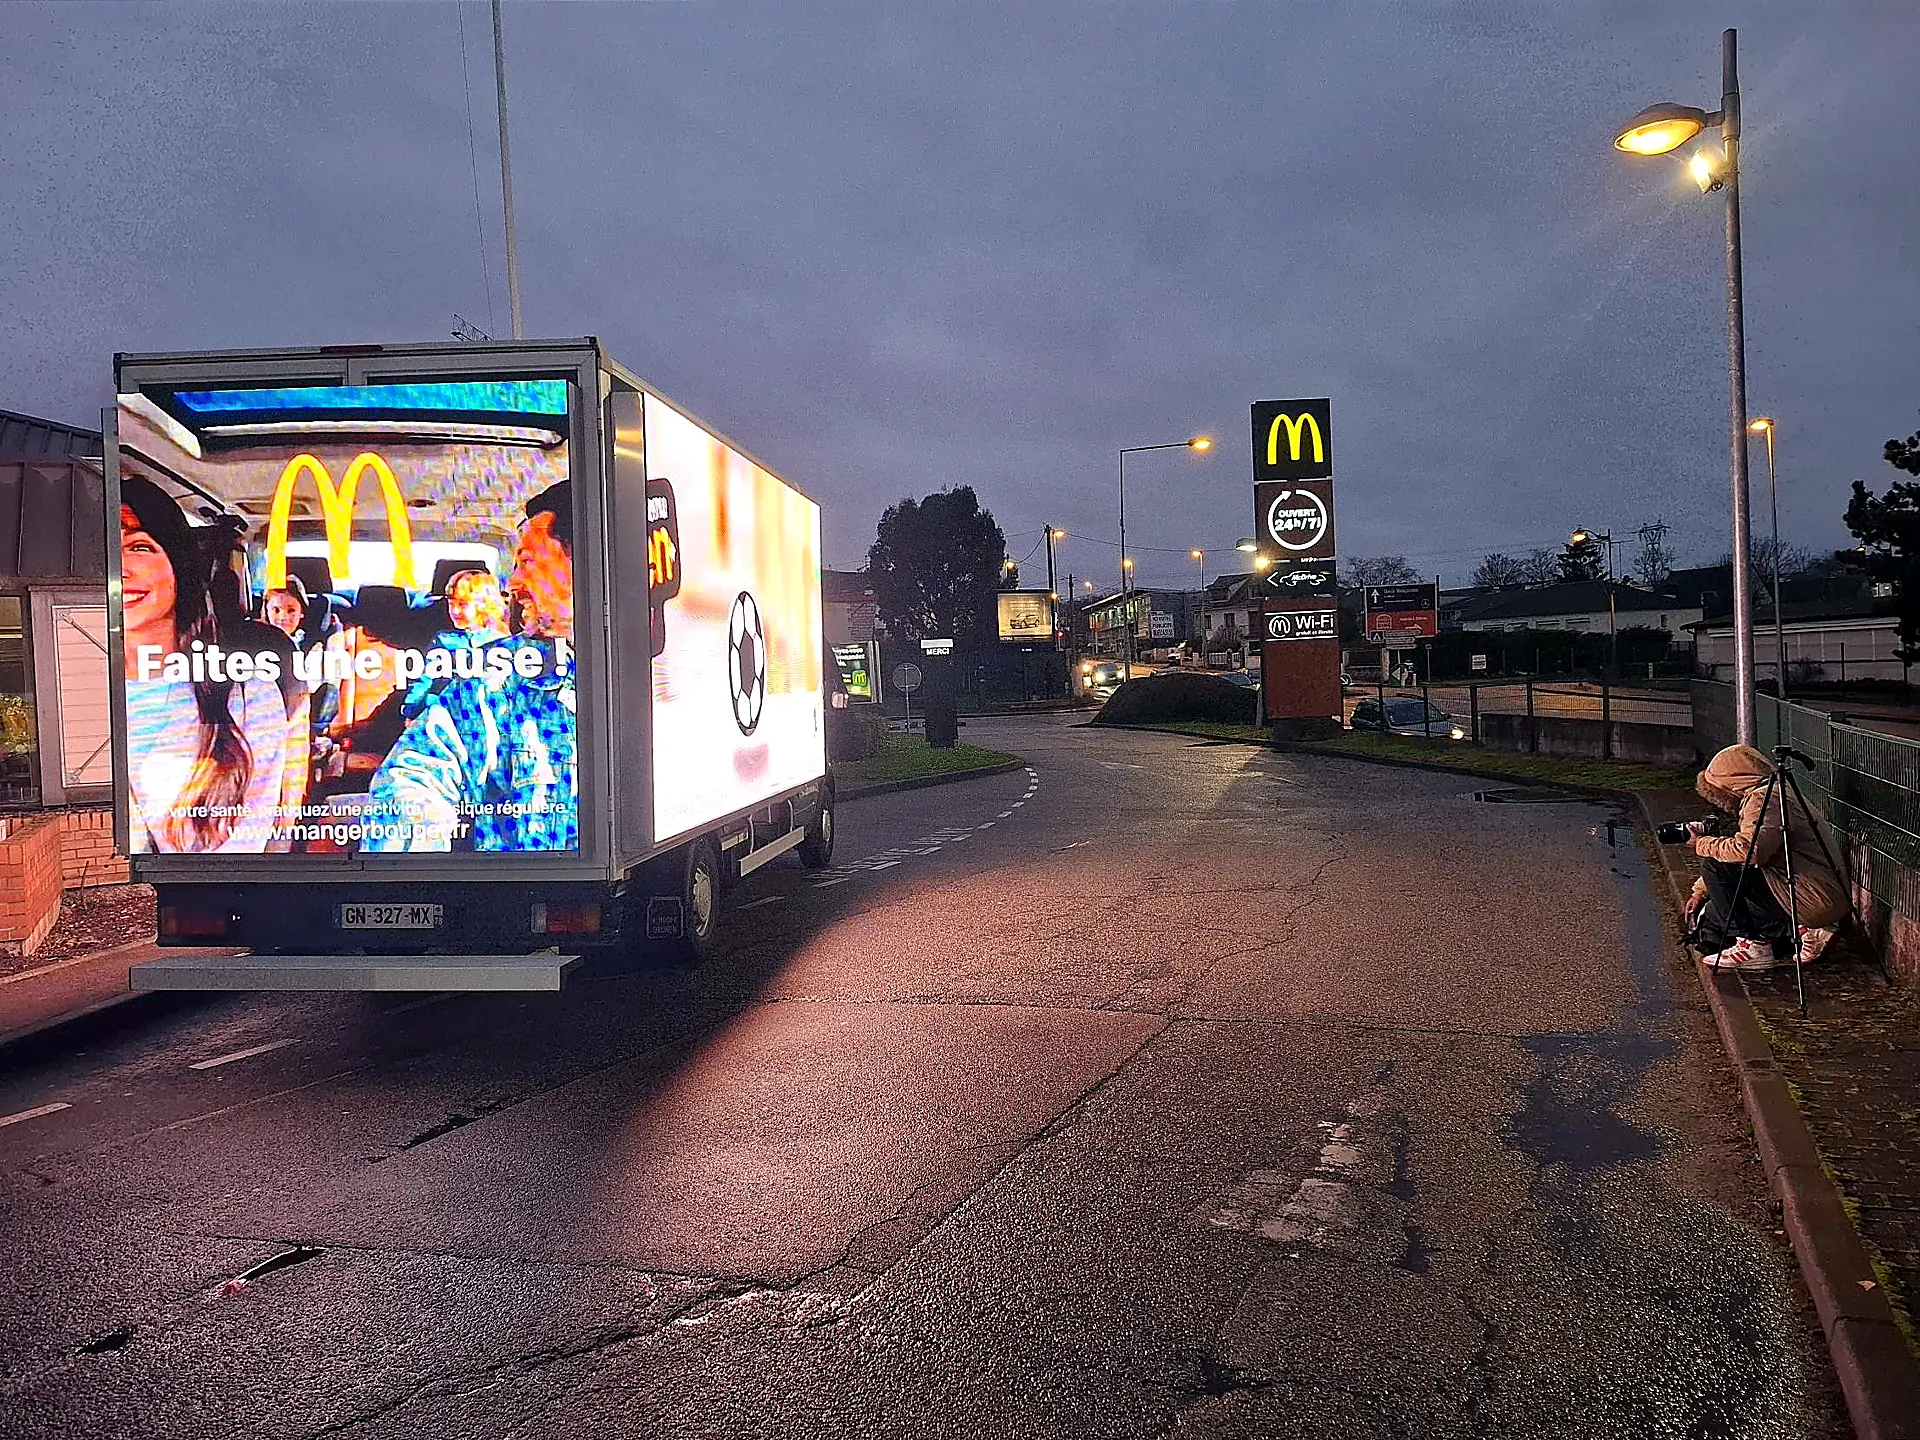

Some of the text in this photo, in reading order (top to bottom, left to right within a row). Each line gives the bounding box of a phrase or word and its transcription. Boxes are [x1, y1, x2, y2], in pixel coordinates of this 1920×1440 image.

[1278, 508, 1316, 518] OUVERT
[1291, 573, 1317, 581] McDrive
[1294, 614, 1334, 630] Wi-Fi
[926, 647, 950, 656] MERCI
[136, 640, 281, 684] Faites
[292, 646, 384, 682] une
[396, 646, 546, 691] pause
[334, 804, 361, 817] une
[228, 818, 470, 846] ww.mangerbouge.fr
[345, 906, 431, 925] GN-327-MX
